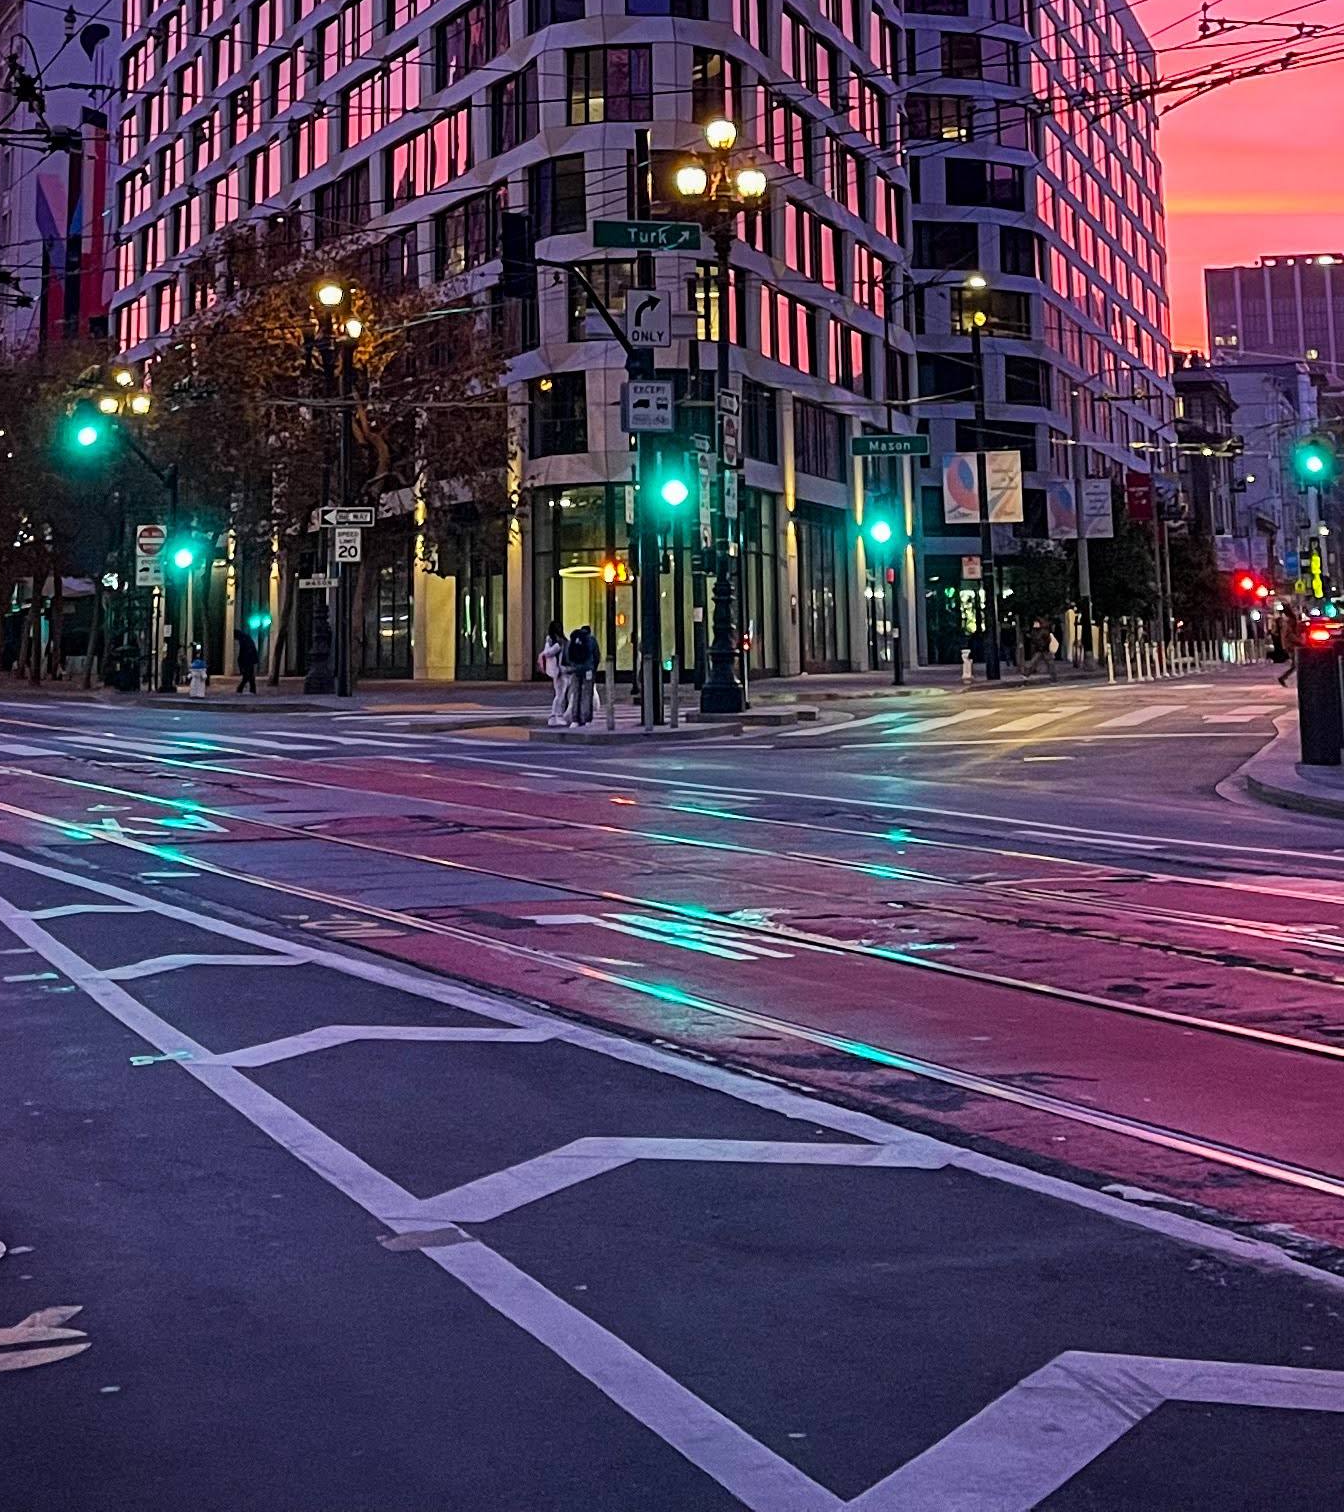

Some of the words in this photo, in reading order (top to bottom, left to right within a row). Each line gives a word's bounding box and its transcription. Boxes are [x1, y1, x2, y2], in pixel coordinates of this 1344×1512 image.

[627, 226, 669, 245] Turk
[631, 330, 665, 343] ONLY
[632, 385, 666, 395] EXCEPT
[868, 440, 911, 451] Mason
[352, 513, 369, 521] WAY
[338, 545, 358, 558] 20
